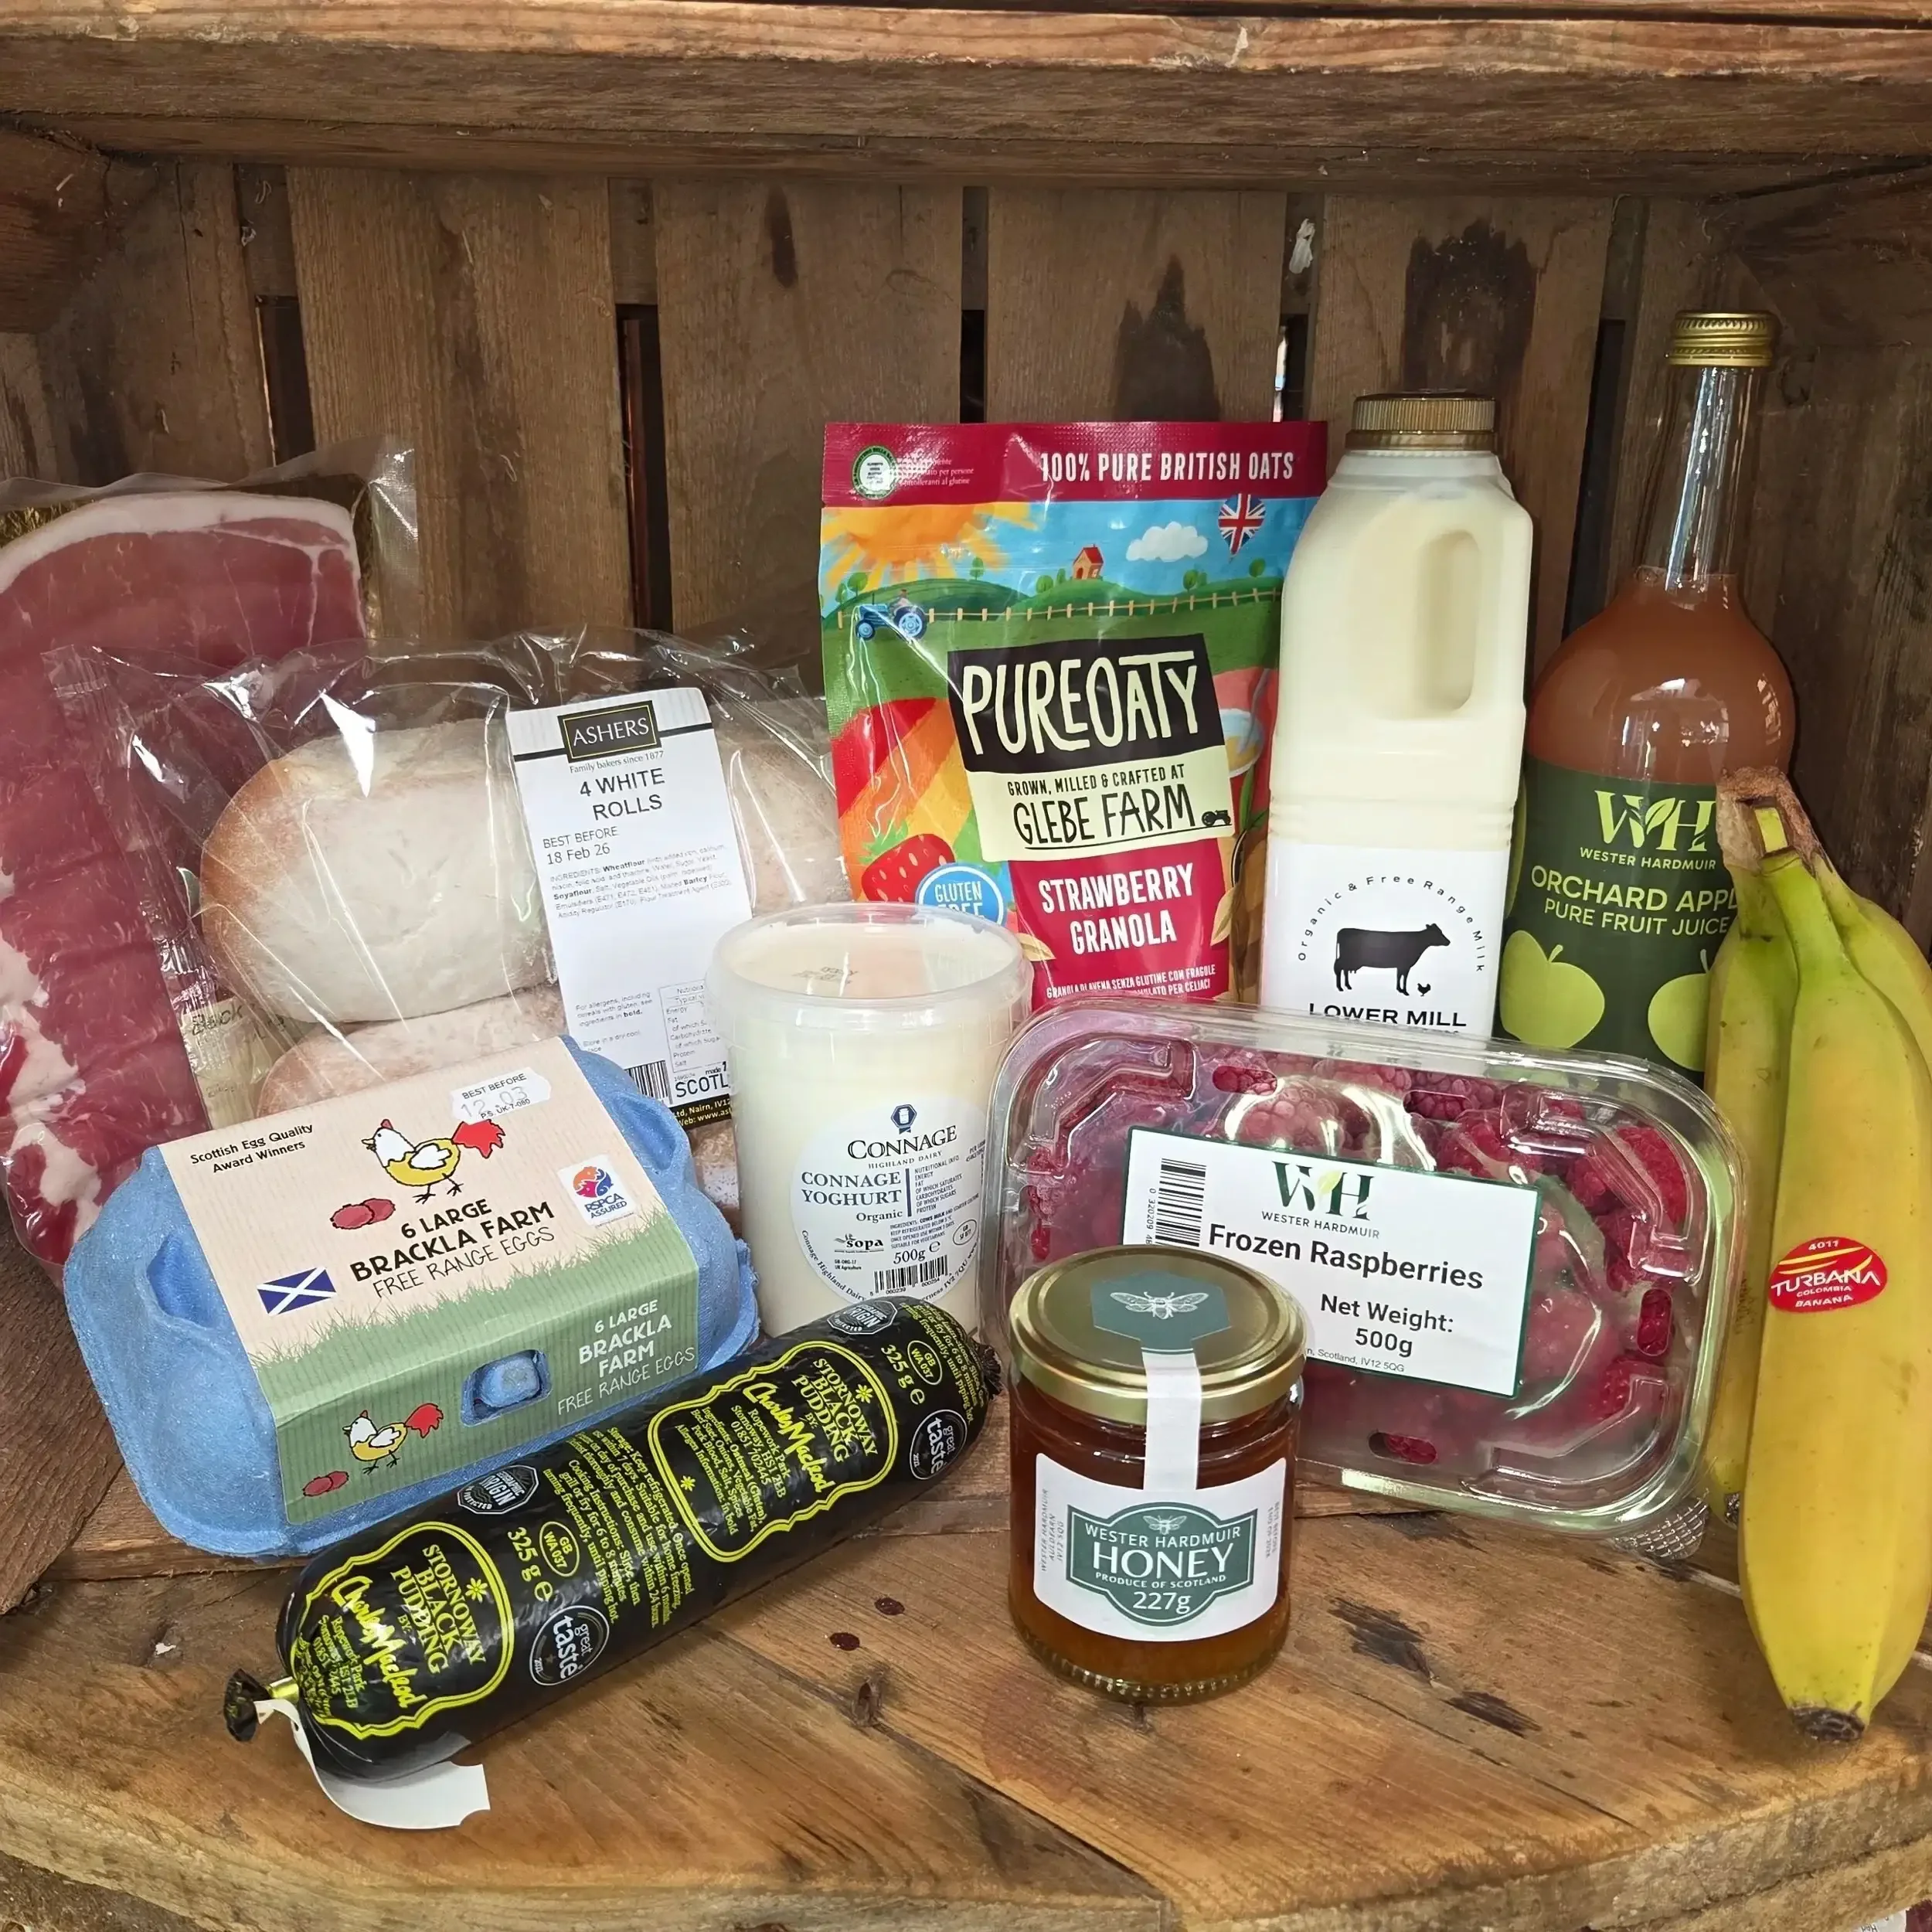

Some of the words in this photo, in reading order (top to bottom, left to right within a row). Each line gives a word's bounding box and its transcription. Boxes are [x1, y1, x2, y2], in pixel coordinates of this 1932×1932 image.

[1041, 453, 1090, 481] 100%
[1098, 453, 1151, 481] PURE
[1160, 453, 1240, 480] BRITISH
[1249, 452, 1294, 480] OATS
[963, 651, 1197, 754] PUREOATY
[573, 718, 649, 747] ASHERS
[570, 761, 595, 774] Family
[597, 757, 621, 769] bakers
[624, 754, 643, 764] since
[645, 750, 663, 760] 1877
[580, 781, 591, 797] 4
[595, 768, 665, 794] WHITE
[1007, 776, 1050, 796] GROWN,
[1055, 773, 1097, 794] MILLED
[1101, 773, 1109, 788] &
[1113, 767, 1166, 787] CRAFTED
[1170, 764, 1185, 781] AT
[593, 794, 662, 820] ROLLS
[1013, 797, 1094, 845] GLEBE
[1101, 784, 1196, 838] FARM
[543, 836, 571, 849] BEST
[575, 826, 617, 843] BEFORE
[546, 853, 562, 865] 18
[567, 846, 590, 861] Feb
[594, 843, 610, 856] 26
[603, 859, 645, 872] Wheatflour
[1580, 847, 1636, 866] WESTER
[1641, 858, 1716, 869] HARDMUIR
[683, 876, 707, 886] Barley
[935, 881, 982, 902] GLUTEN
[1039, 863, 1194, 913] STRAWBERRY
[1532, 866, 1668, 911] ORCHARD
[1675, 889, 1738, 913] APPL
[1298, 893, 1342, 961] Organic
[1366, 876, 1414, 885] Free
[1423, 880, 1473, 923] Range
[1472, 930, 1485, 971] Milk
[1544, 898, 1595, 925] PURE
[1601, 913, 1666, 934] FRUIT
[1672, 917, 1730, 936] JUICE
[1070, 910, 1177, 955] GRANOLA
[1112, 977, 1134, 989] SENZA
[1135, 972, 1167, 987] GLUTINE
[1185, 964, 1216, 979] FRAGOLE
[1168, 983, 1183, 995] PER
[1185, 979, 1210, 992] CELIACI
[624, 1009, 642, 1018] bold.
[1309, 1003, 1398, 1024] LOWER
[1407, 1011, 1466, 1026] MILL
[462, 1087, 486, 1099] BEST
[488, 1073, 526, 1091] BEFORE
[675, 1073, 728, 1097] SCOTL
[497, 1099, 530, 1114] UK-7-080
[689, 1104, 713, 1114] Nairn,
[190, 1143, 239, 1164] Scottish
[242, 1136, 266, 1153] Egg
[269, 1123, 313, 1143] Quality
[213, 1155, 253, 1173] Award
[256, 1140, 305, 1160] Winners
[848, 1125, 957, 1159] CONNAGE
[869, 1158, 915, 1168] HIGHLAND
[918, 1151, 943, 1162] DAIRY
[915, 1161, 947, 1174] NUTRITIONAL
[801, 1172, 901, 1188] CONNAGE
[915, 1172, 933, 1180] ENERGY
[923, 1183, 938, 1192] WHICH
[584, 1193, 624, 1212] RSPCA
[801, 1190, 901, 1206] YOGHURT
[916, 1185, 953, 1200] CARBOHYDRATES
[400, 1223, 417, 1238] 6
[420, 1199, 492, 1233] LARGE
[591, 1201, 627, 1219] ASSURED
[856, 1209, 903, 1223] Organic
[1147, 1199, 1155, 1230] 320209
[1262, 1212, 1309, 1228] WESTER
[1315, 1221, 1380, 1240] HARDMUIR
[349, 1229, 478, 1283] BRACKLA
[480, 1201, 555, 1241] FARM
[846, 1240, 883, 1250] sopa
[893, 1248, 925, 1264] 500g
[1210, 1224, 1301, 1260] Frozen
[1310, 1240, 1483, 1289] Raspberries
[1808, 1240, 1838, 1250] 4011
[372, 1270, 420, 1298] FREE
[428, 1245, 498, 1281] RANGE
[501, 1226, 555, 1256] EGGS
[802, 1230, 818, 1261] Connage
[818, 1261, 846, 1290] Highland
[1771, 1270, 1880, 1296] TURBANA
[1797, 1285, 1852, 1297] COLOMBIA
[1321, 1294, 1360, 1318] Net
[1368, 1302, 1453, 1333] Weight:
[1795, 1294, 1852, 1307] BANANA
[594, 1320, 604, 1333] 6
[609, 1300, 658, 1328] LARGE
[580, 1315, 672, 1364] BRACKLA
[1355, 1328, 1413, 1357] 500g
[599, 1340, 654, 1377] FARM
[881, 1345, 909, 1372] 325
[898, 1375, 914, 1388] g
[912, 1349, 924, 1364] WA
[920, 1363, 934, 1378] 037
[924, 1353, 936, 1366] GB
[1318, 1349, 1358, 1364] Scotland,
[1361, 1358, 1381, 1368] IV12
[1383, 1362, 1404, 1372] 5QG
[558, 1388, 594, 1415] FREE
[600, 1364, 650, 1398] RANGE
[656, 1347, 695, 1374] EGGS
[743, 1383, 794, 1434] Charles
[791, 1375, 849, 1463] PUDDING
[805, 1413, 818, 1429] BY:
[812, 1376, 859, 1445] BLACK
[813, 1359, 878, 1456] STORNOWAY
[731, 1405, 764, 1452] Stornoway,
[762, 1451, 777, 1473] HS1
[731, 1421, 753, 1447] 01851
[747, 1448, 772, 1485] 702445
[748, 1408, 781, 1454] Ropework
[776, 1454, 791, 1478] Park
[927, 1417, 946, 1474] taste
[943, 1426, 955, 1454] great
[691, 1425, 707, 1445] Pork
[728, 1489, 743, 1518] Spices
[730, 1444, 754, 1481] Oatmeal
[568, 1460, 594, 1492] Cooking
[590, 1490, 625, 1549] Instructions:
[696, 1451, 724, 1503] Information:
[725, 1515, 738, 1536] bold
[733, 1470, 753, 1513] Vegetable
[630, 1451, 648, 1478] Keep
[673, 1533, 687, 1562] Once
[508, 1527, 539, 1561] 325
[544, 1531, 558, 1550] WA
[552, 1549, 567, 1568] 037
[560, 1537, 573, 1553] GB
[1085, 1523, 1148, 1547] WESTER
[1156, 1526, 1240, 1547] HARDMUIR
[522, 1564, 541, 1582] g
[1094, 1542, 1233, 1579] HONEY
[1096, 1572, 1147, 1588] PRODUCE
[1171, 1575, 1226, 1588] SCOTLAND
[414, 1567, 464, 1655] BLACK
[423, 1544, 486, 1665] STORNOWAY
[1133, 1591, 1192, 1614] 227g
[390, 1566, 448, 1674] PUDDING
[397, 1614, 410, 1634] BY:
[553, 1615, 580, 1679] taste
[575, 1623, 593, 1657] great
